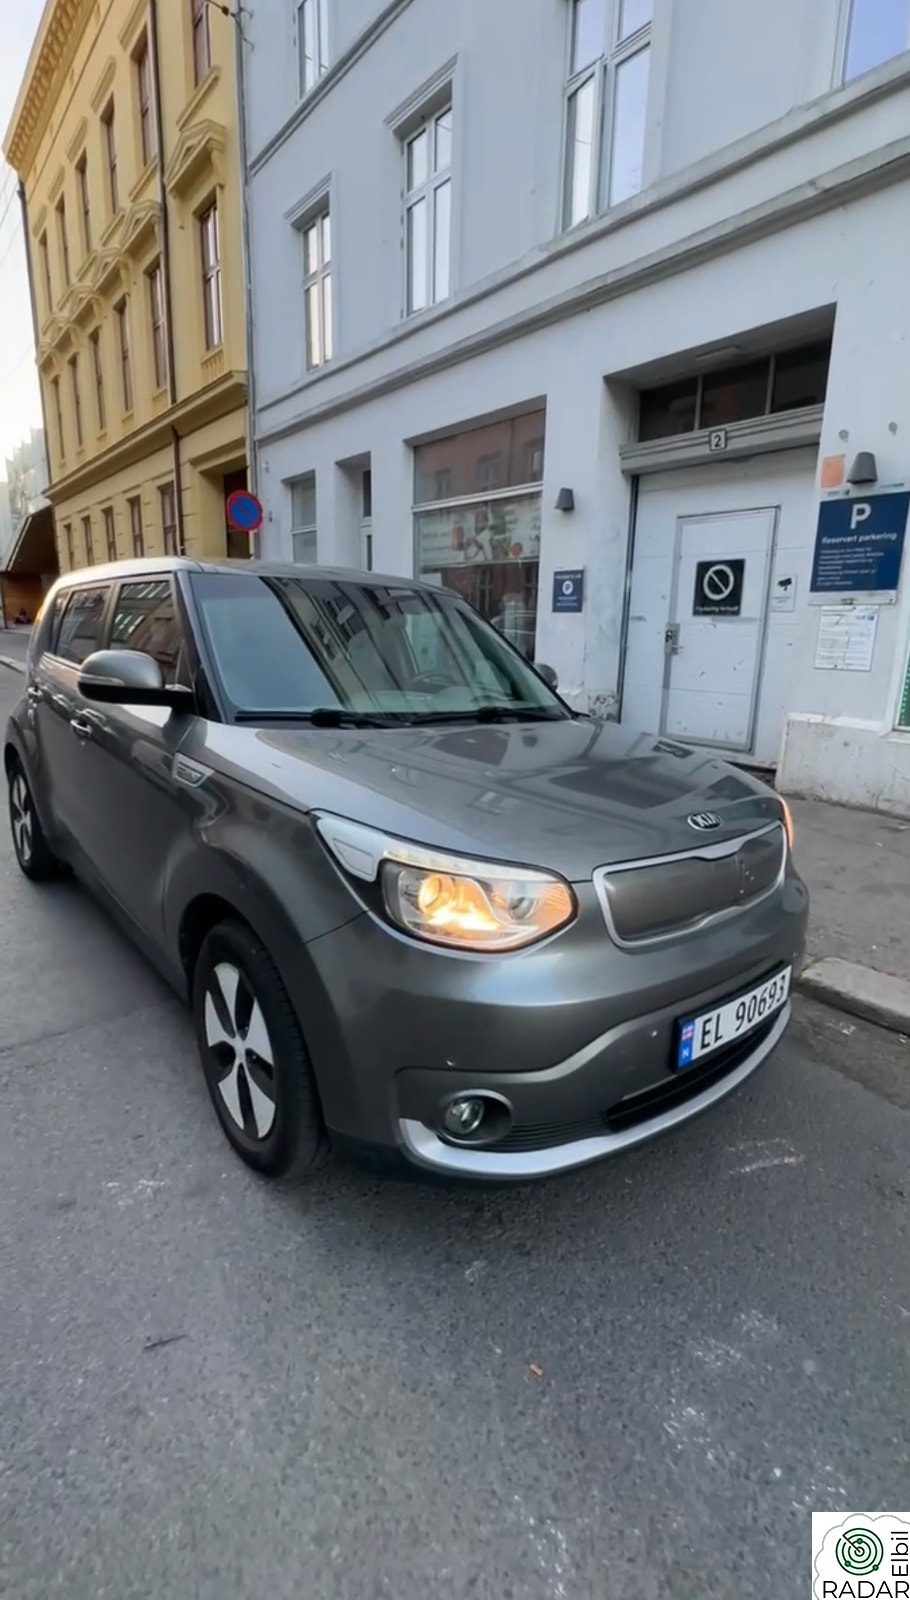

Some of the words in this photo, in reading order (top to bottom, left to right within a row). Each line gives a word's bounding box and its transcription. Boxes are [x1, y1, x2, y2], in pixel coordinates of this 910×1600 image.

[714, 434, 722, 448] 2
[850, 503, 872, 530] P
[821, 535, 858, 544] Reservert
[858, 532, 897, 543] parkering
[692, 812, 721, 828] KIA
[701, 1013, 723, 1050] EL
[735, 974, 786, 1032] 90693
[682, 1047, 690, 1059] N
